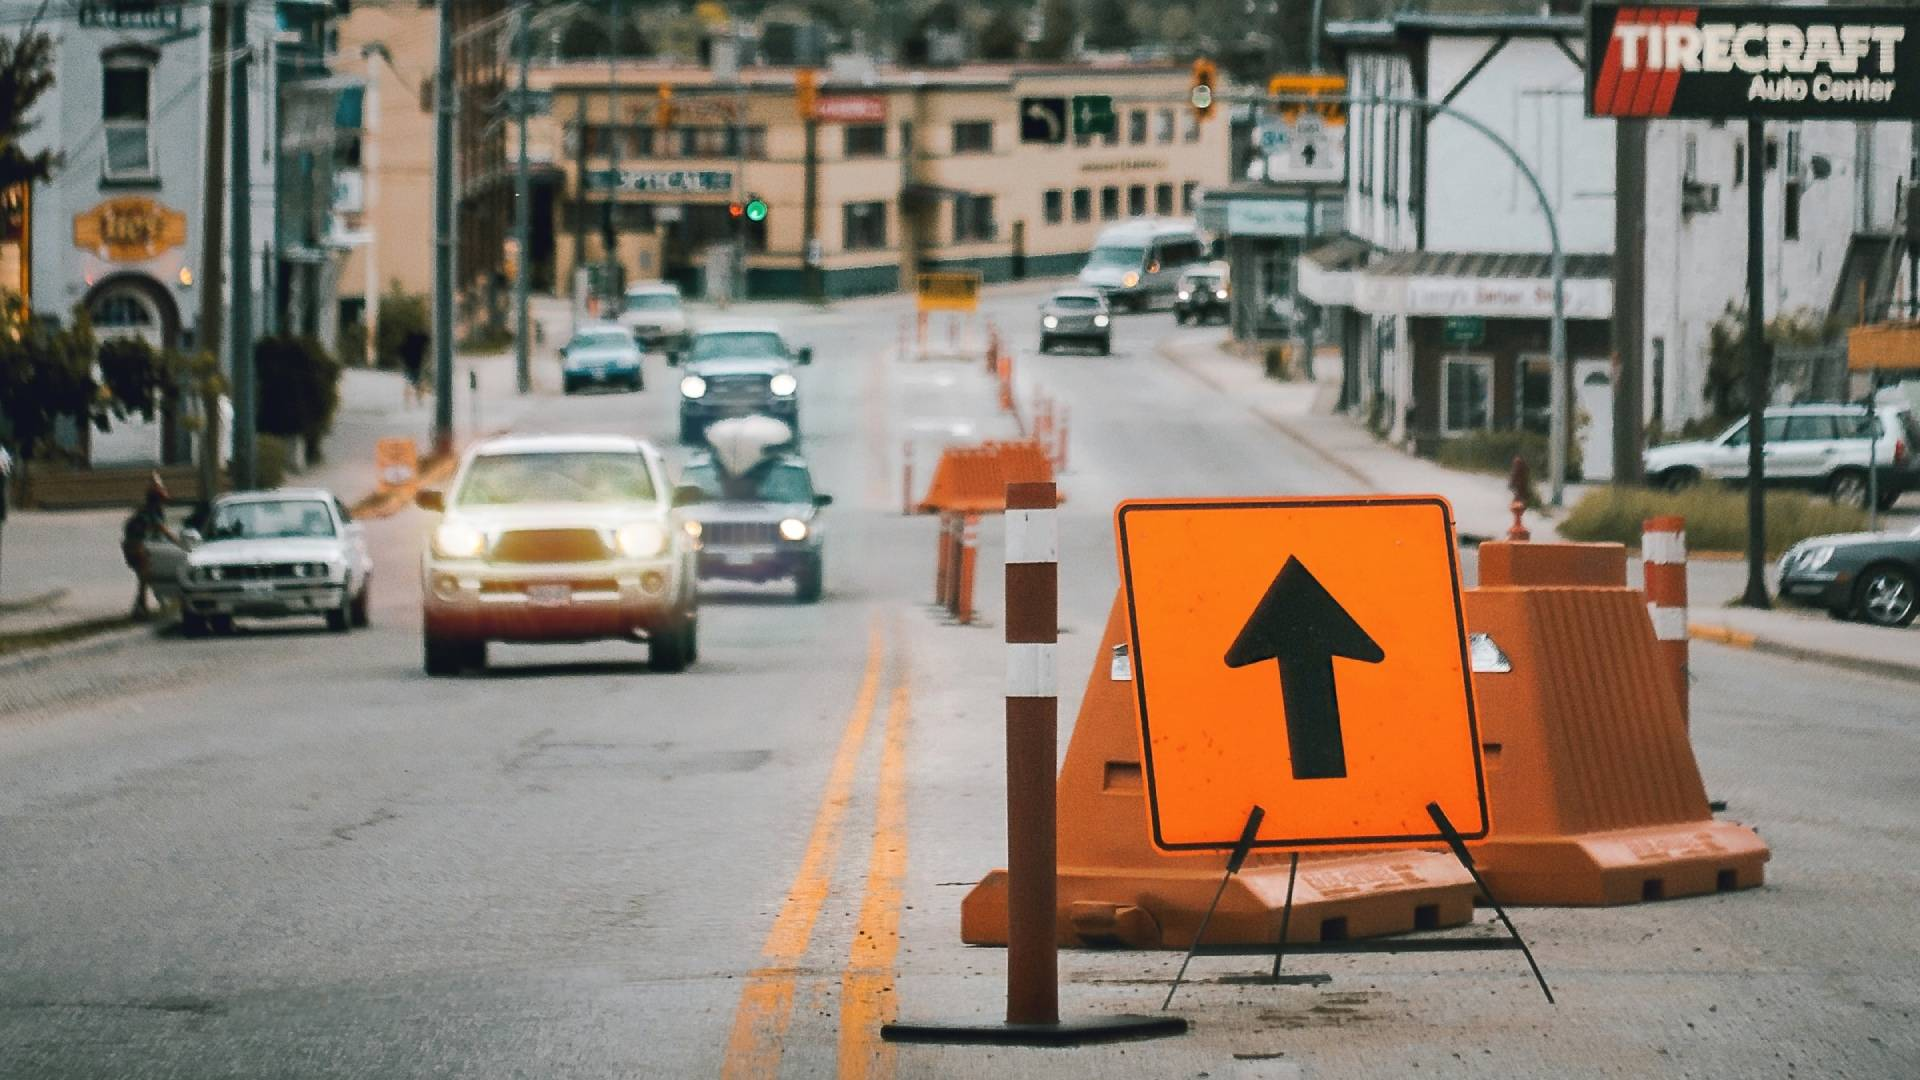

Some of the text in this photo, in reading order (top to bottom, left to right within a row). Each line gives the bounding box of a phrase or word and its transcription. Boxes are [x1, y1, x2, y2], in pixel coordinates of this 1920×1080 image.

[1614, 23, 1905, 73] TIRECRAFT
[1749, 74, 1896, 101] Auto Center
